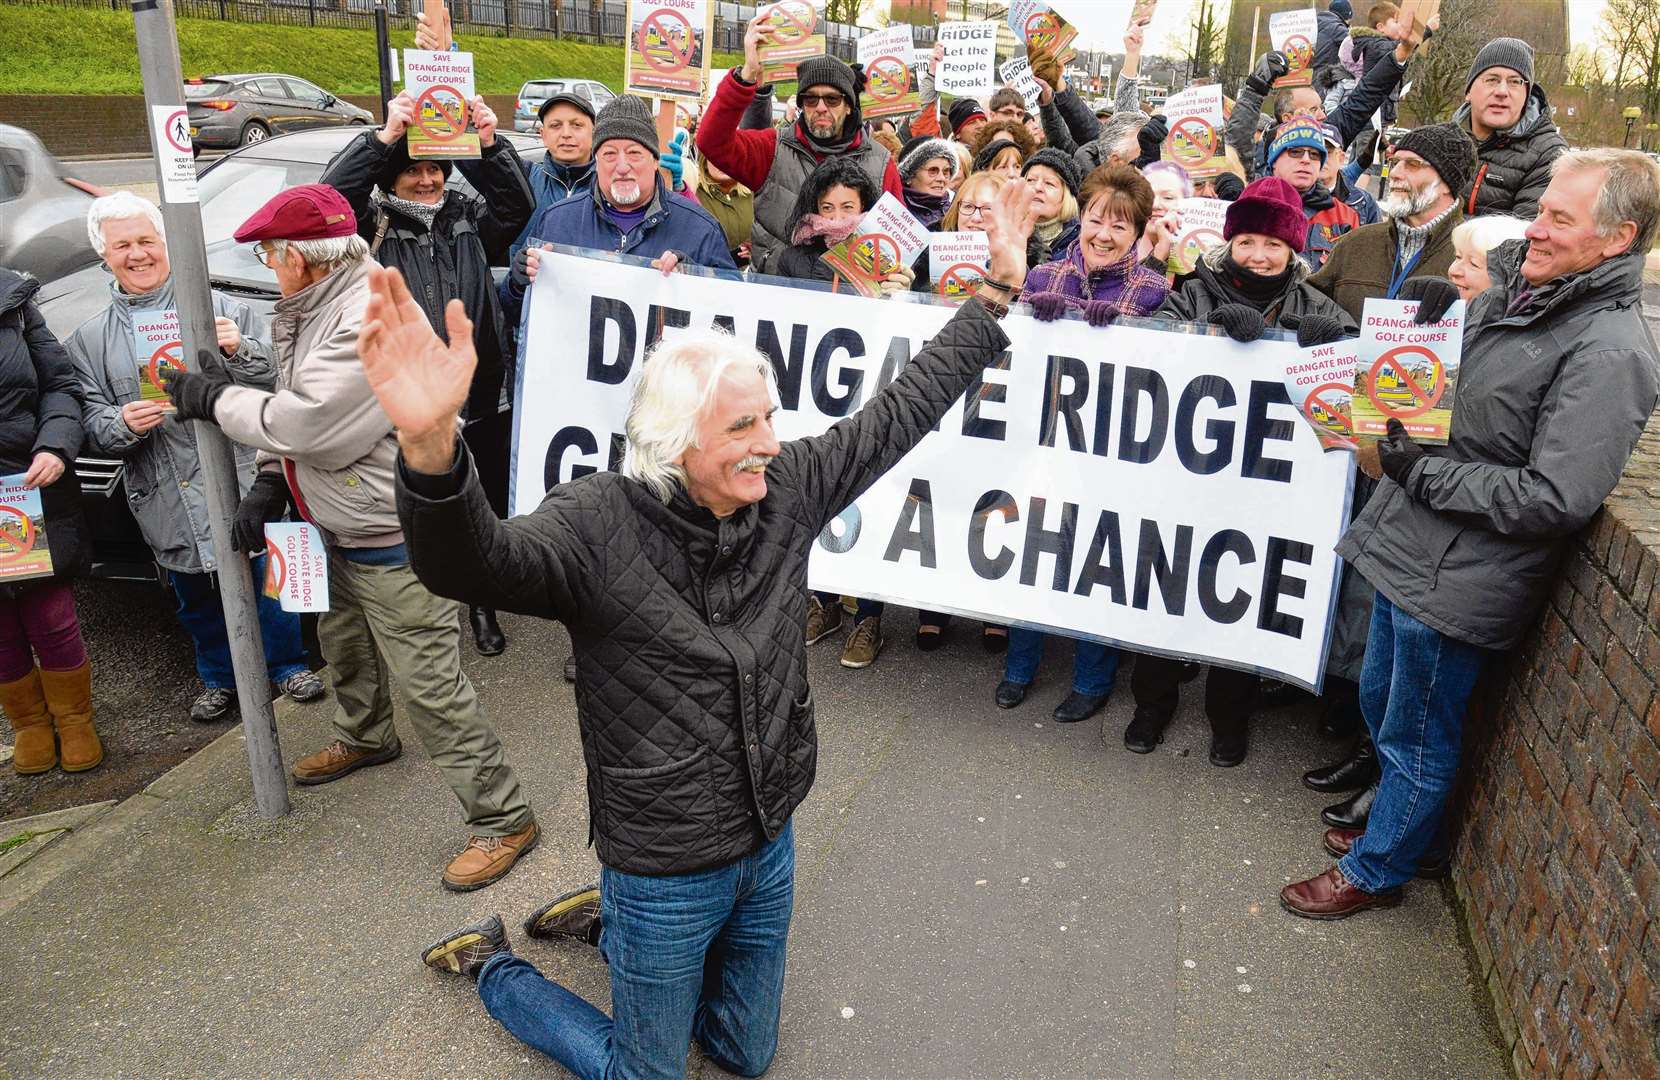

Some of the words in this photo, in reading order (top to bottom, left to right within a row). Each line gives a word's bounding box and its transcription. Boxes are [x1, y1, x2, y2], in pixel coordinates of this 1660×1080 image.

[889, 36, 910, 44] RIDGE
[941, 29, 993, 41] RIDGE
[879, 45, 905, 55] COURSE
[943, 47, 963, 56] Let
[968, 46, 988, 56] the
[433, 54, 452, 62] SAVE
[408, 63, 450, 74] DEANGATE
[451, 65, 471, 74] RIDGE
[914, 62, 931, 72] RID
[943, 62, 987, 74] People
[1004, 61, 1030, 82] RIDG
[416, 74, 437, 83] GOLF
[438, 76, 467, 84] COURSE
[942, 77, 987, 90] Speak!
[1022, 86, 1040, 99] ople
[1198, 96, 1218, 105] RIDGE
[1186, 107, 1213, 116] COURSE
[1204, 201, 1223, 209] SAVE
[900, 211, 916, 227] SAVE
[1185, 208, 1219, 219] EANGATE
[878, 204, 909, 234] DEANGATE
[907, 229, 925, 250] RIDGE
[1185, 217, 1203, 225] GOLF
[1206, 220, 1223, 229] COU
[877, 217, 894, 234] GOLF
[892, 231, 916, 254] COURSE
[933, 244, 973, 252] DEANGATE
[939, 254, 959, 262] GOLF
[960, 254, 989, 262] COURSE
[163, 312, 178, 320] SAV
[1403, 305, 1423, 315] SAV
[147, 333, 172, 342] GOLF
[1375, 332, 1405, 343] GOLF
[1407, 332, 1448, 343] COURSE
[1311, 346, 1336, 359] SAVE
[1286, 361, 1336, 376] DEANGATE
[1336, 355, 1358, 370] RIDG
[1296, 376, 1321, 387] GOLF
[1322, 368, 1354, 382] COURS
[1039, 355, 1296, 483] RIDGE
[0, 494, 28, 503] URSE
[287, 535, 297, 561] GOLF
[300, 526, 310, 577] DEANGATE
[882, 477, 937, 569] A
[967, 488, 1314, 640] CHANCE
[314, 554, 324, 579] SAVE
[288, 562, 299, 600] COURSE
[302, 579, 312, 608] RIDGE
